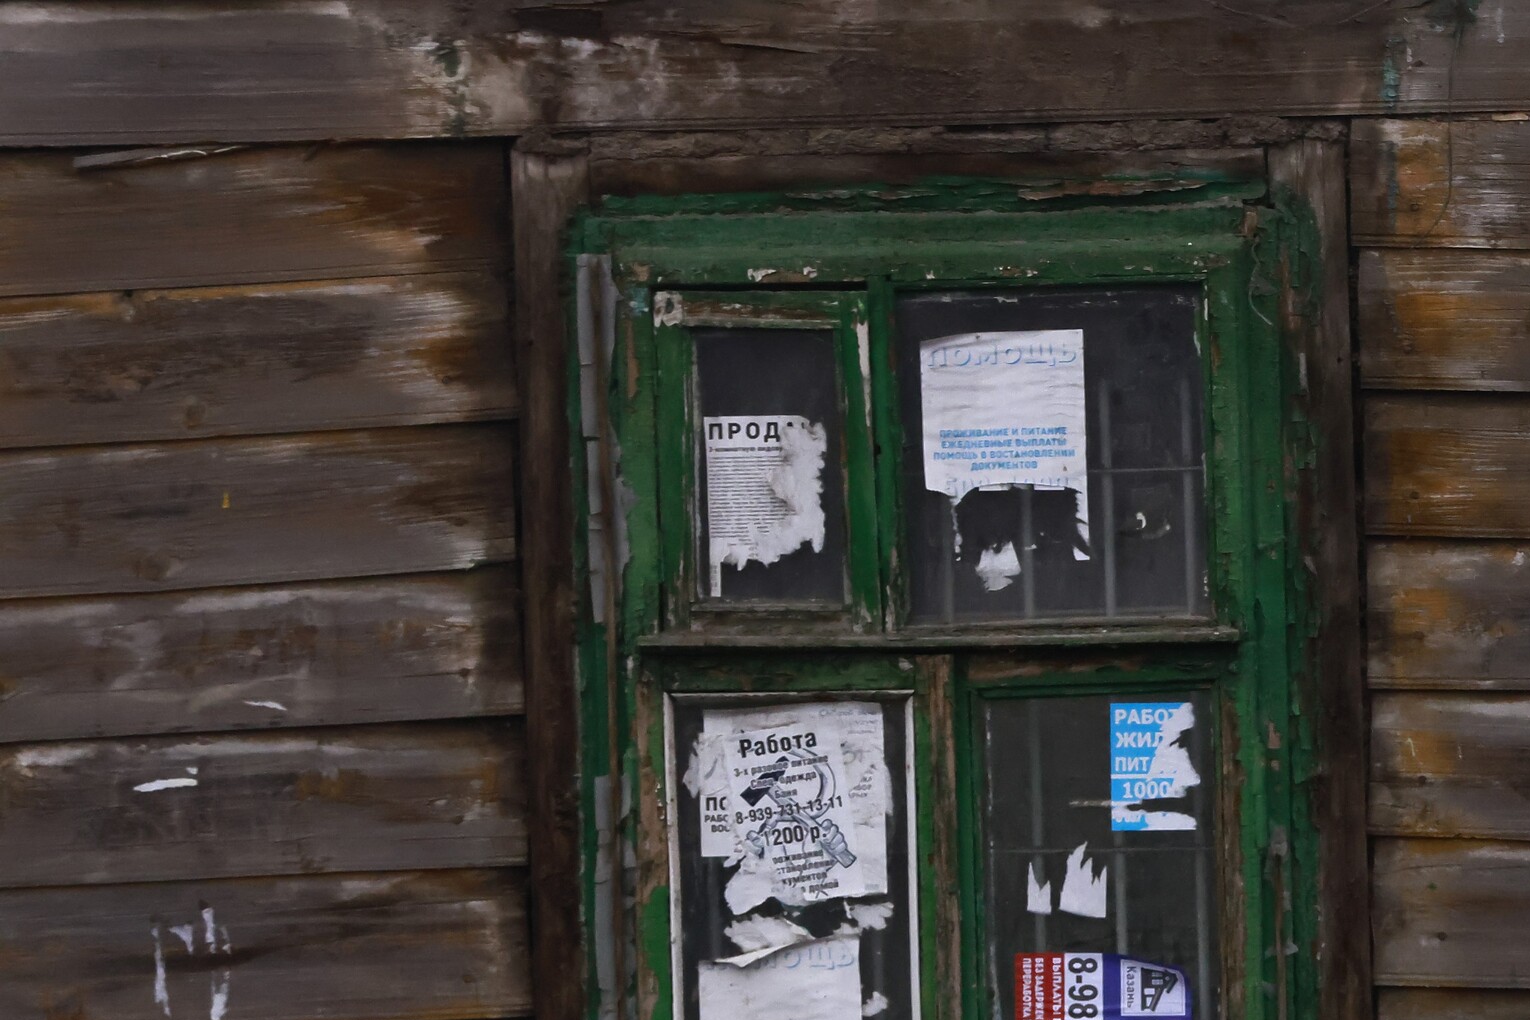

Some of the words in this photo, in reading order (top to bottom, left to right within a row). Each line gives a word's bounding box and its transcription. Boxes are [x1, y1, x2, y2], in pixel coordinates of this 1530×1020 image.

[1013, 428, 1018, 436] И
[1022, 427, 1067, 436] ПИТАНИЕ
[941, 438, 1012, 449] ЕЖЕДНЕВНЫЕ
[1016, 438, 1067, 447] ВЫПЛАТЫ
[934, 451, 978, 461] ПОМОЩЬ
[981, 450, 986, 458] В
[971, 461, 1038, 471] ДОКУМЕНТОВ
[739, 732, 817, 758] Работа
[791, 755, 828, 767] питание
[780, 772, 817, 784] одежда
[775, 789, 798, 798] Баня
[1123, 781, 1170, 799] 1000
[735, 796, 843, 824] 8-939-731-13-11
[764, 825, 804, 846] 1200
[1035, 958, 1044, 972] БЕЗ
[1023, 958, 1031, 1017] ПЕРЕРАБОТКА
[1053, 958, 1061, 1014] ВЫПЛАТЫ
[1126, 966, 1136, 1008] Казань
[1035, 975, 1044, 1020] ЗАДЕРЖЕК
